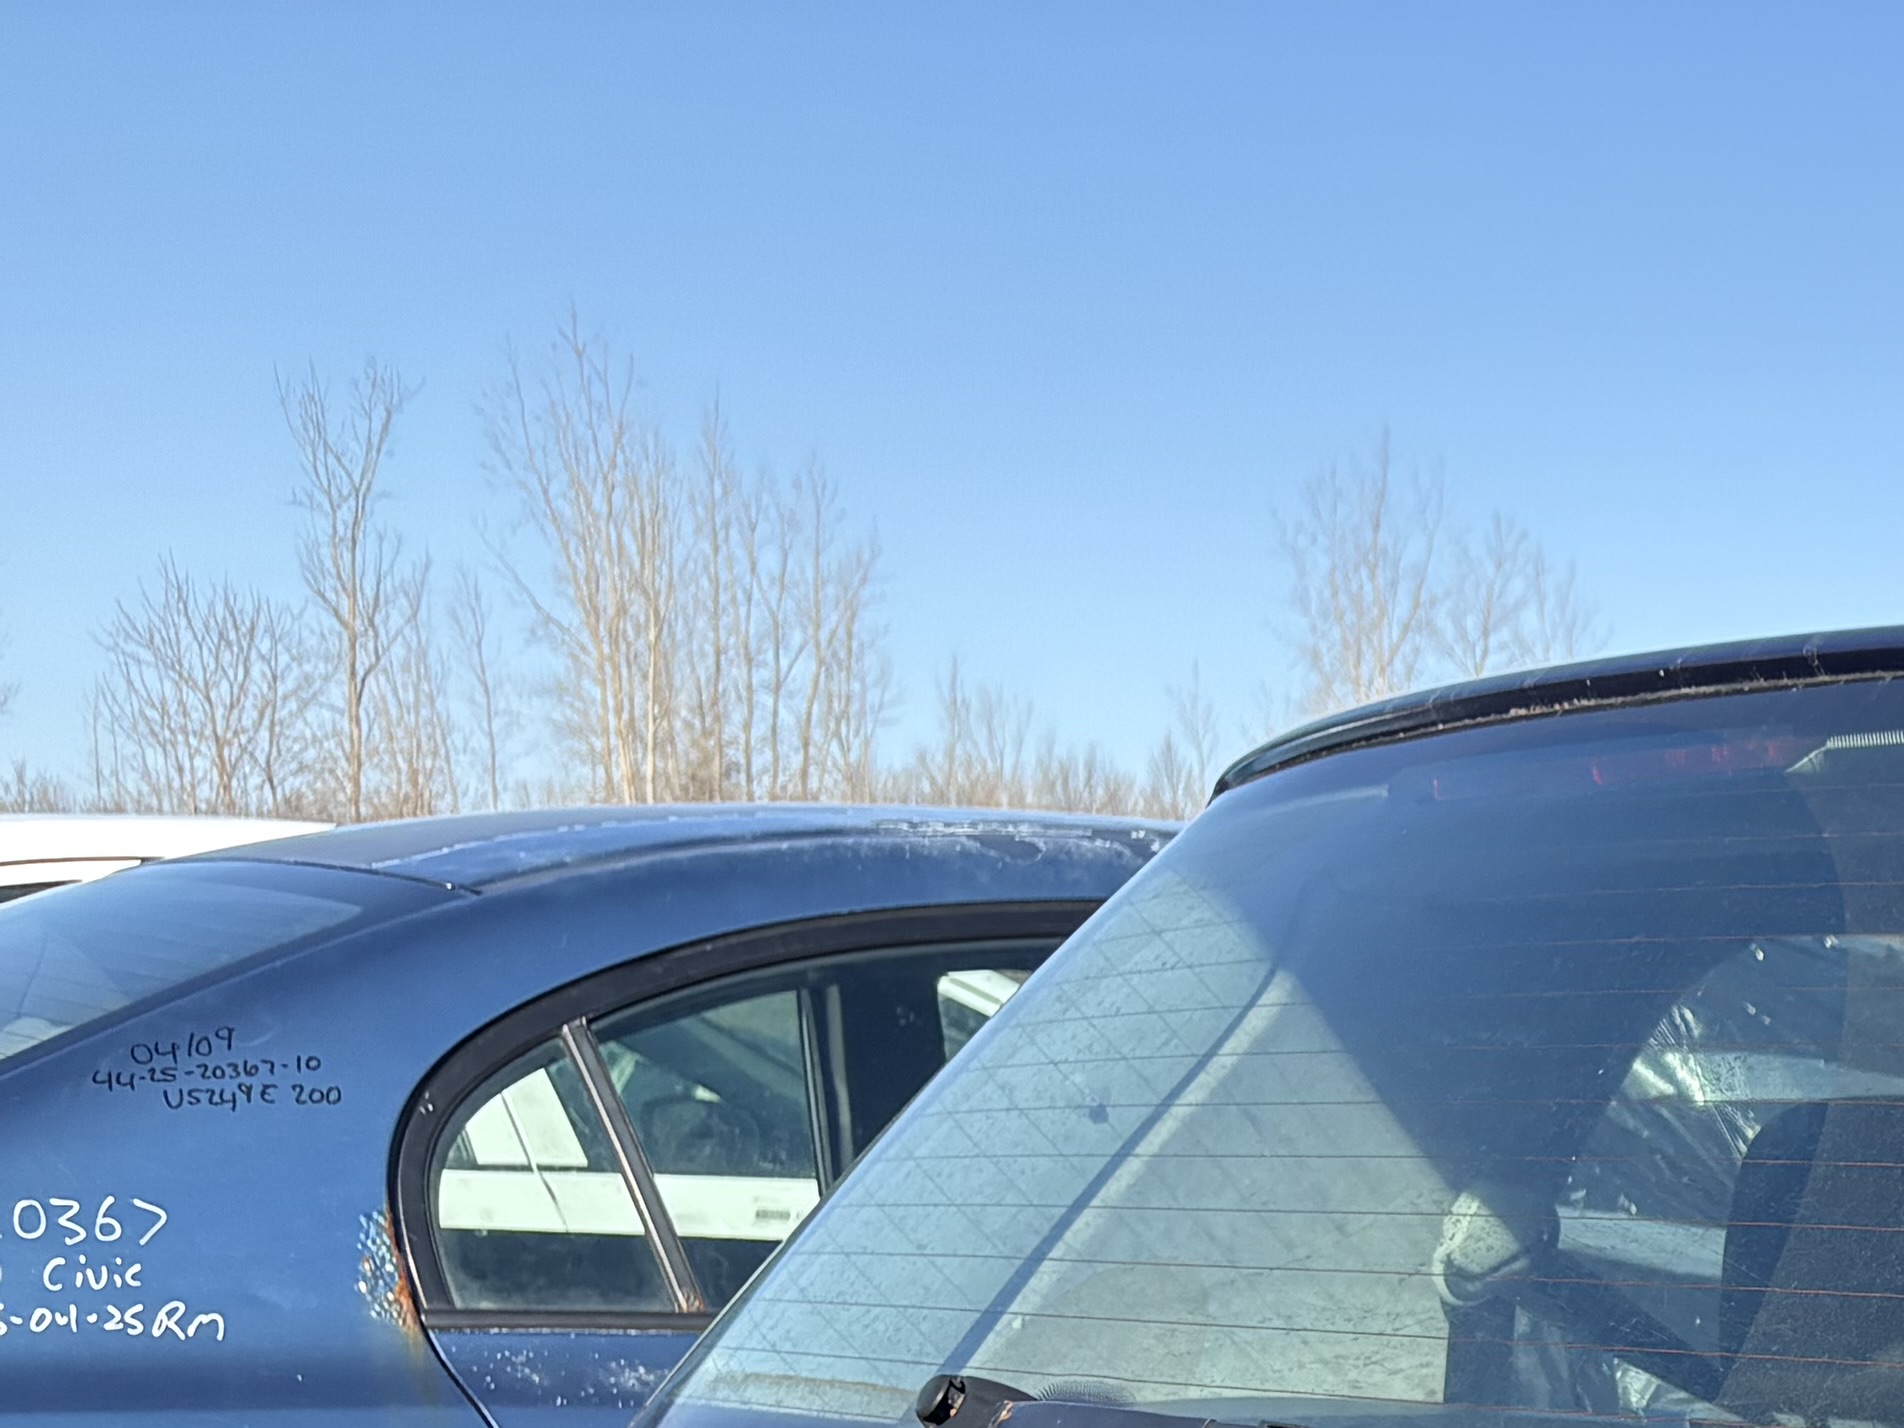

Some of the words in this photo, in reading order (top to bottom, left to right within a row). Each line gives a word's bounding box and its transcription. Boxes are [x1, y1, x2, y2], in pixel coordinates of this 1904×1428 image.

[292, 1083, 342, 1106] 200
[0, 1196, 167, 1246] 0367
[43, 1254, 142, 1291] Civic
